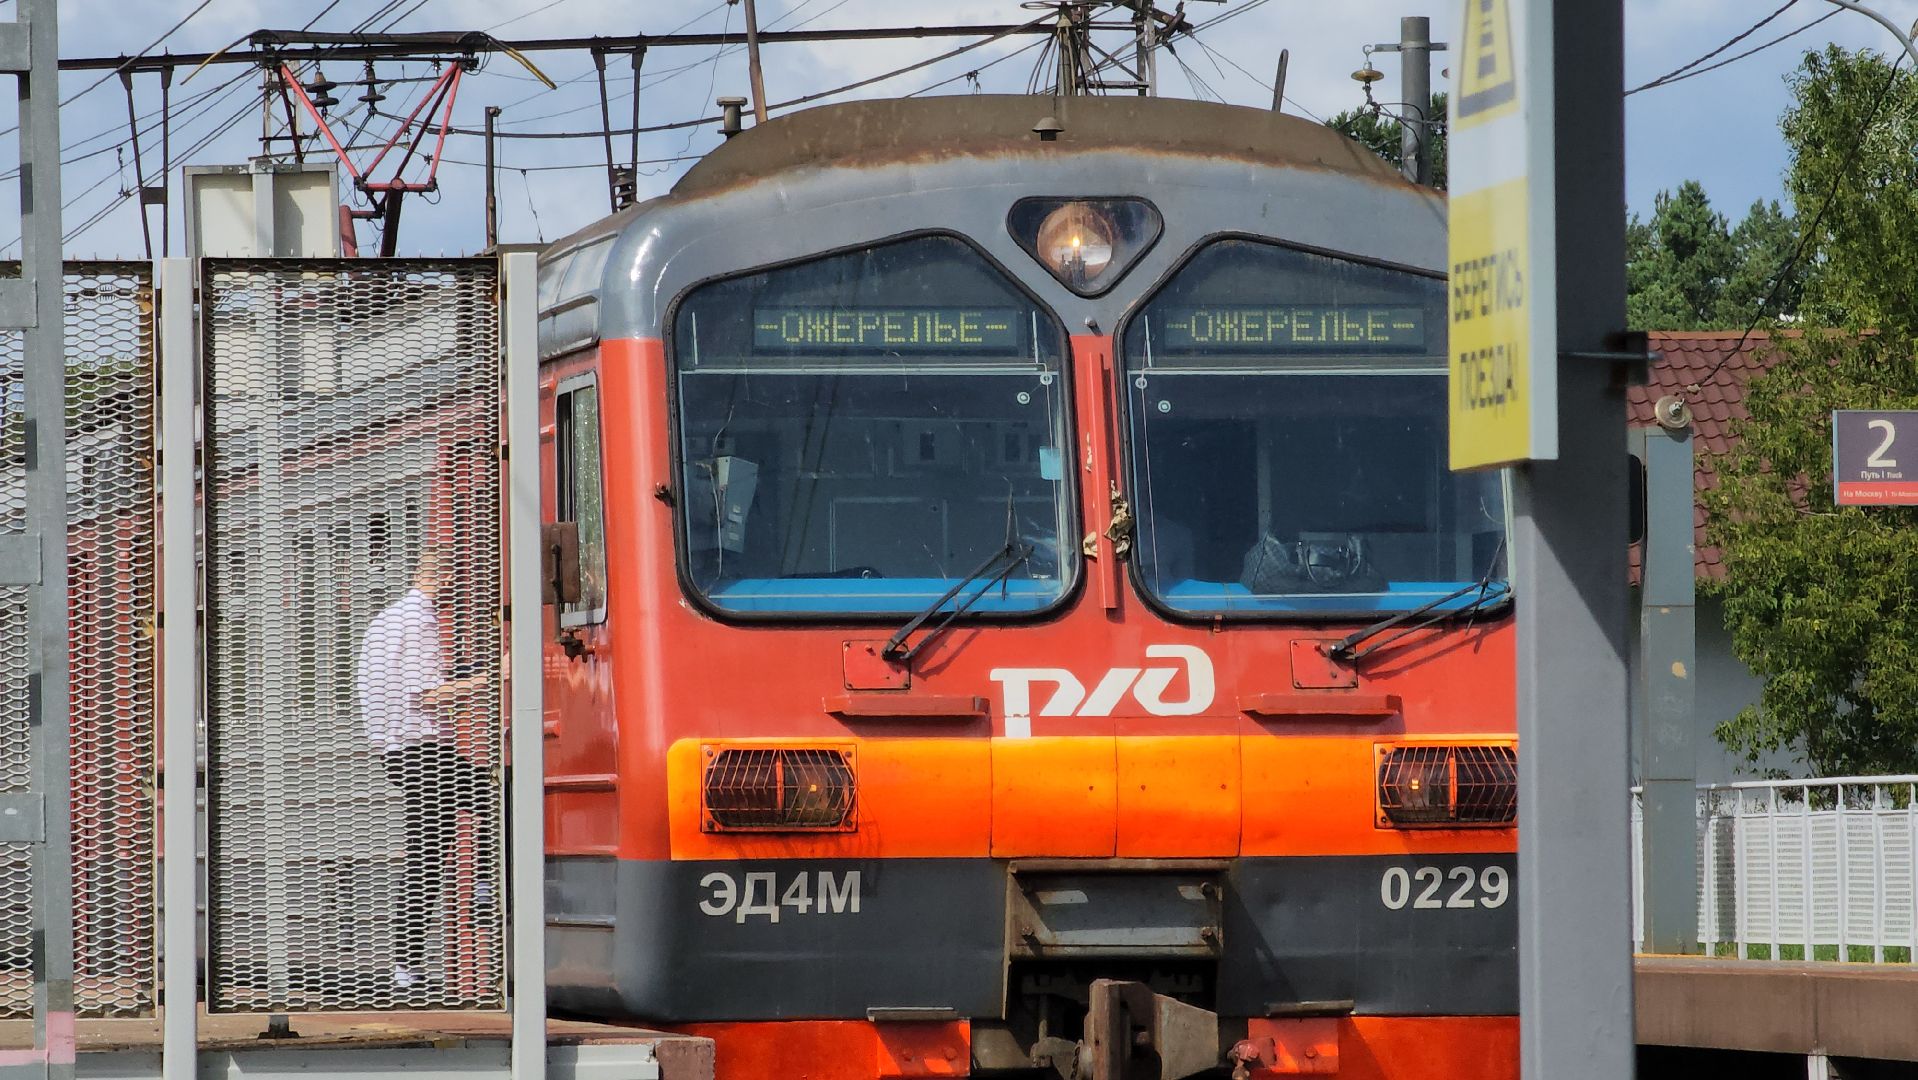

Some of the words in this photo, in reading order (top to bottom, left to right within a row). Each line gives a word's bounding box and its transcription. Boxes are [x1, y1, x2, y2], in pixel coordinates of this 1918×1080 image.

[1867, 419, 1896, 467] 2
[1861, 471, 1880, 481] Путь
[699, 871, 862, 924] ЭД4М
[1380, 866, 1509, 910] 0229
